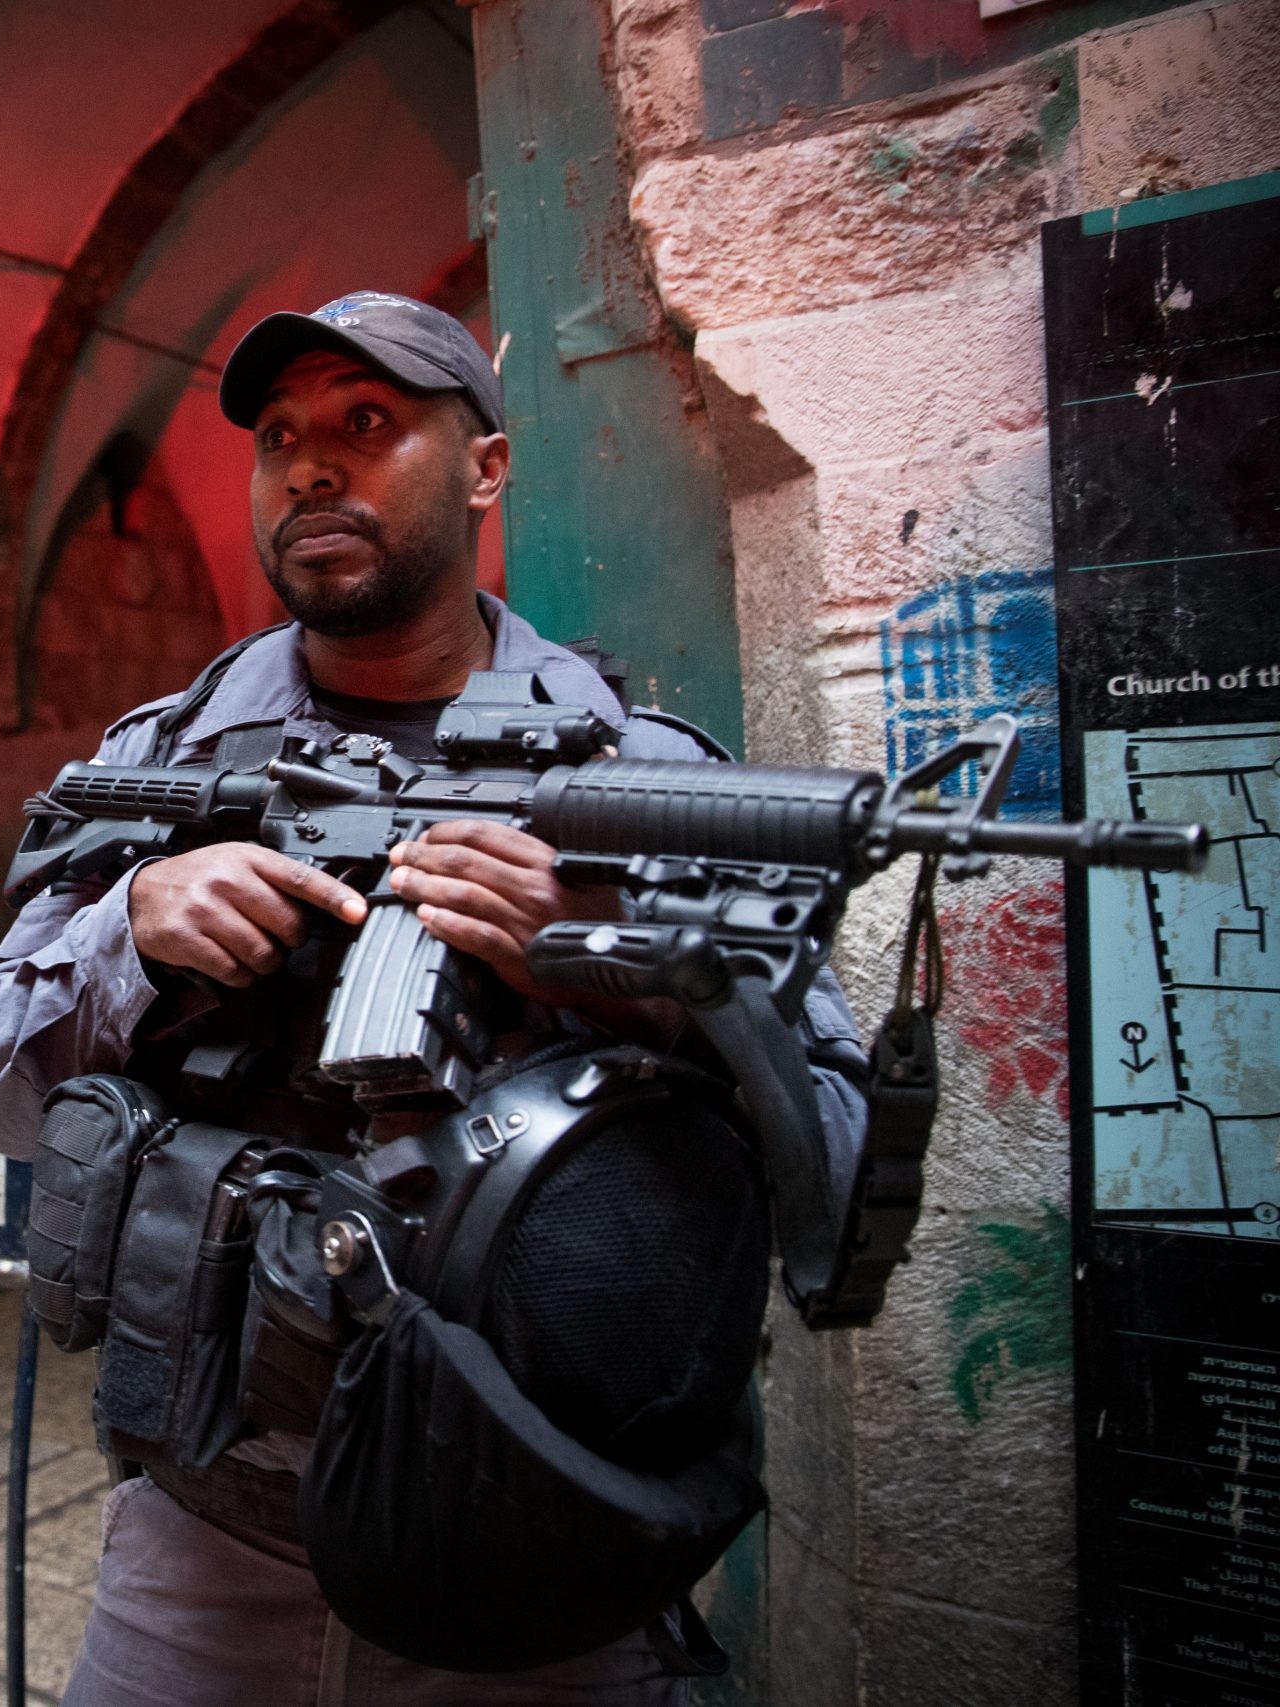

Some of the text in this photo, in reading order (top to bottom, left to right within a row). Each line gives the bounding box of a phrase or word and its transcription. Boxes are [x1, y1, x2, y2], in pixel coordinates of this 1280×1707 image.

[1106, 669, 1211, 697] Church
[1218, 665, 1252, 690] of
[1207, 1444, 1225, 1455] of
[1128, 1498, 1190, 1519] Convent
[1191, 1511, 1209, 1522] of
[1182, 1576, 1211, 1592] The
[1173, 1643, 1204, 1660] The
[1206, 1651, 1249, 1671] Small
